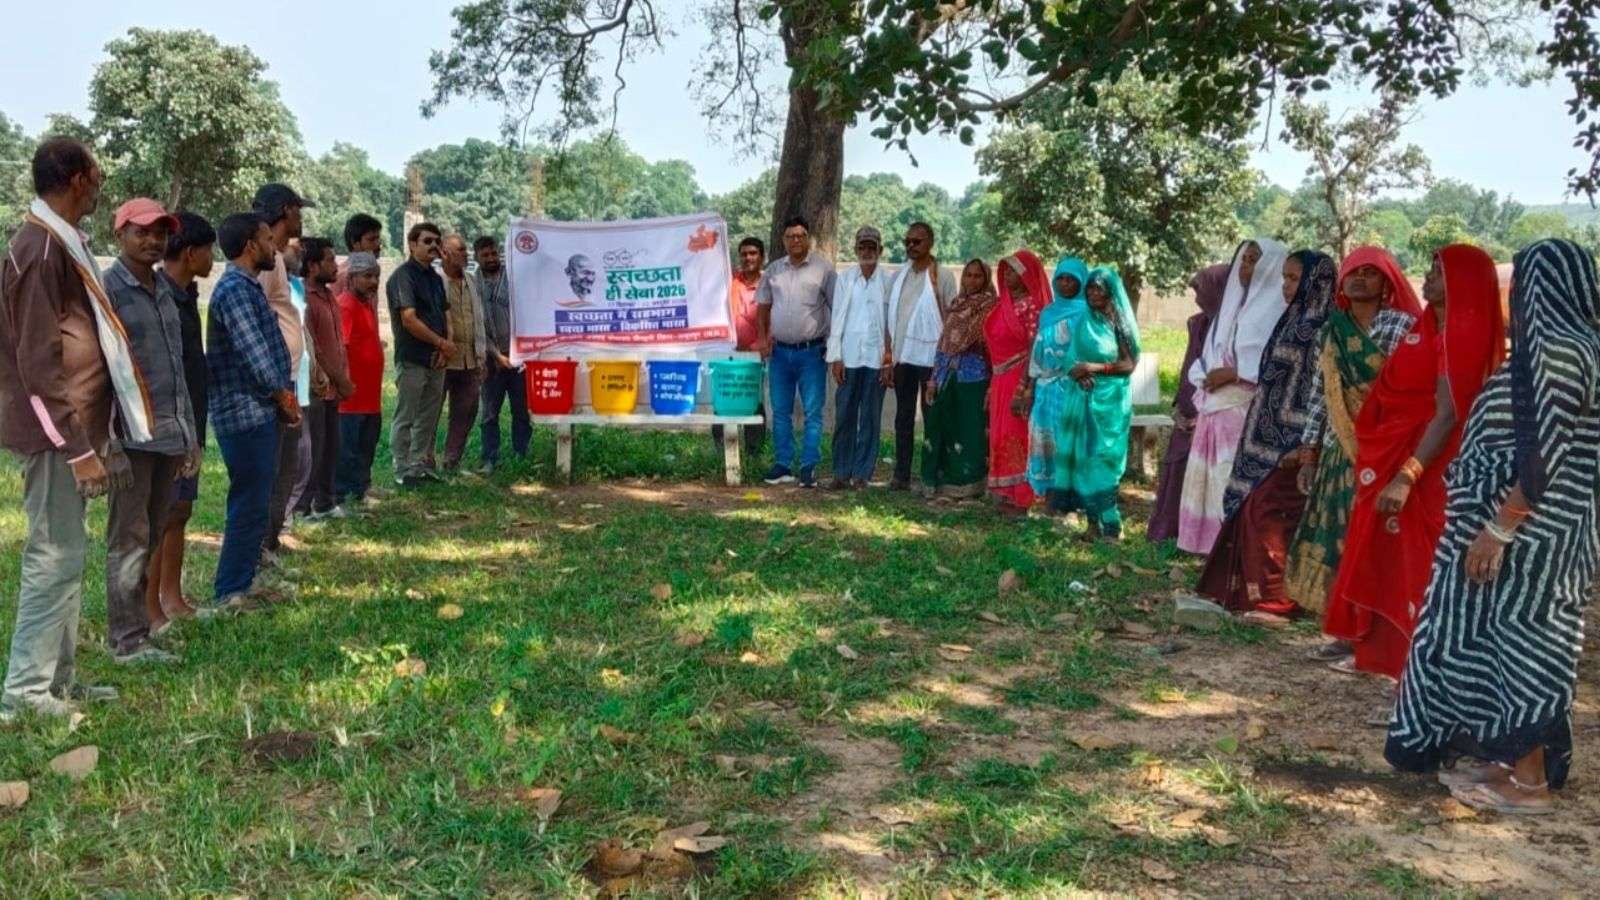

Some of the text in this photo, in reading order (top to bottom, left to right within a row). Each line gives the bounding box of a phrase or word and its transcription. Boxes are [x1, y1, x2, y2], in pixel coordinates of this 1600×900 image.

[605, 268, 681, 284] स्वच्छता
[605, 285, 621, 301] ही
[624, 284, 655, 301] सेवा
[567, 310, 614, 322] स्वच्छता
